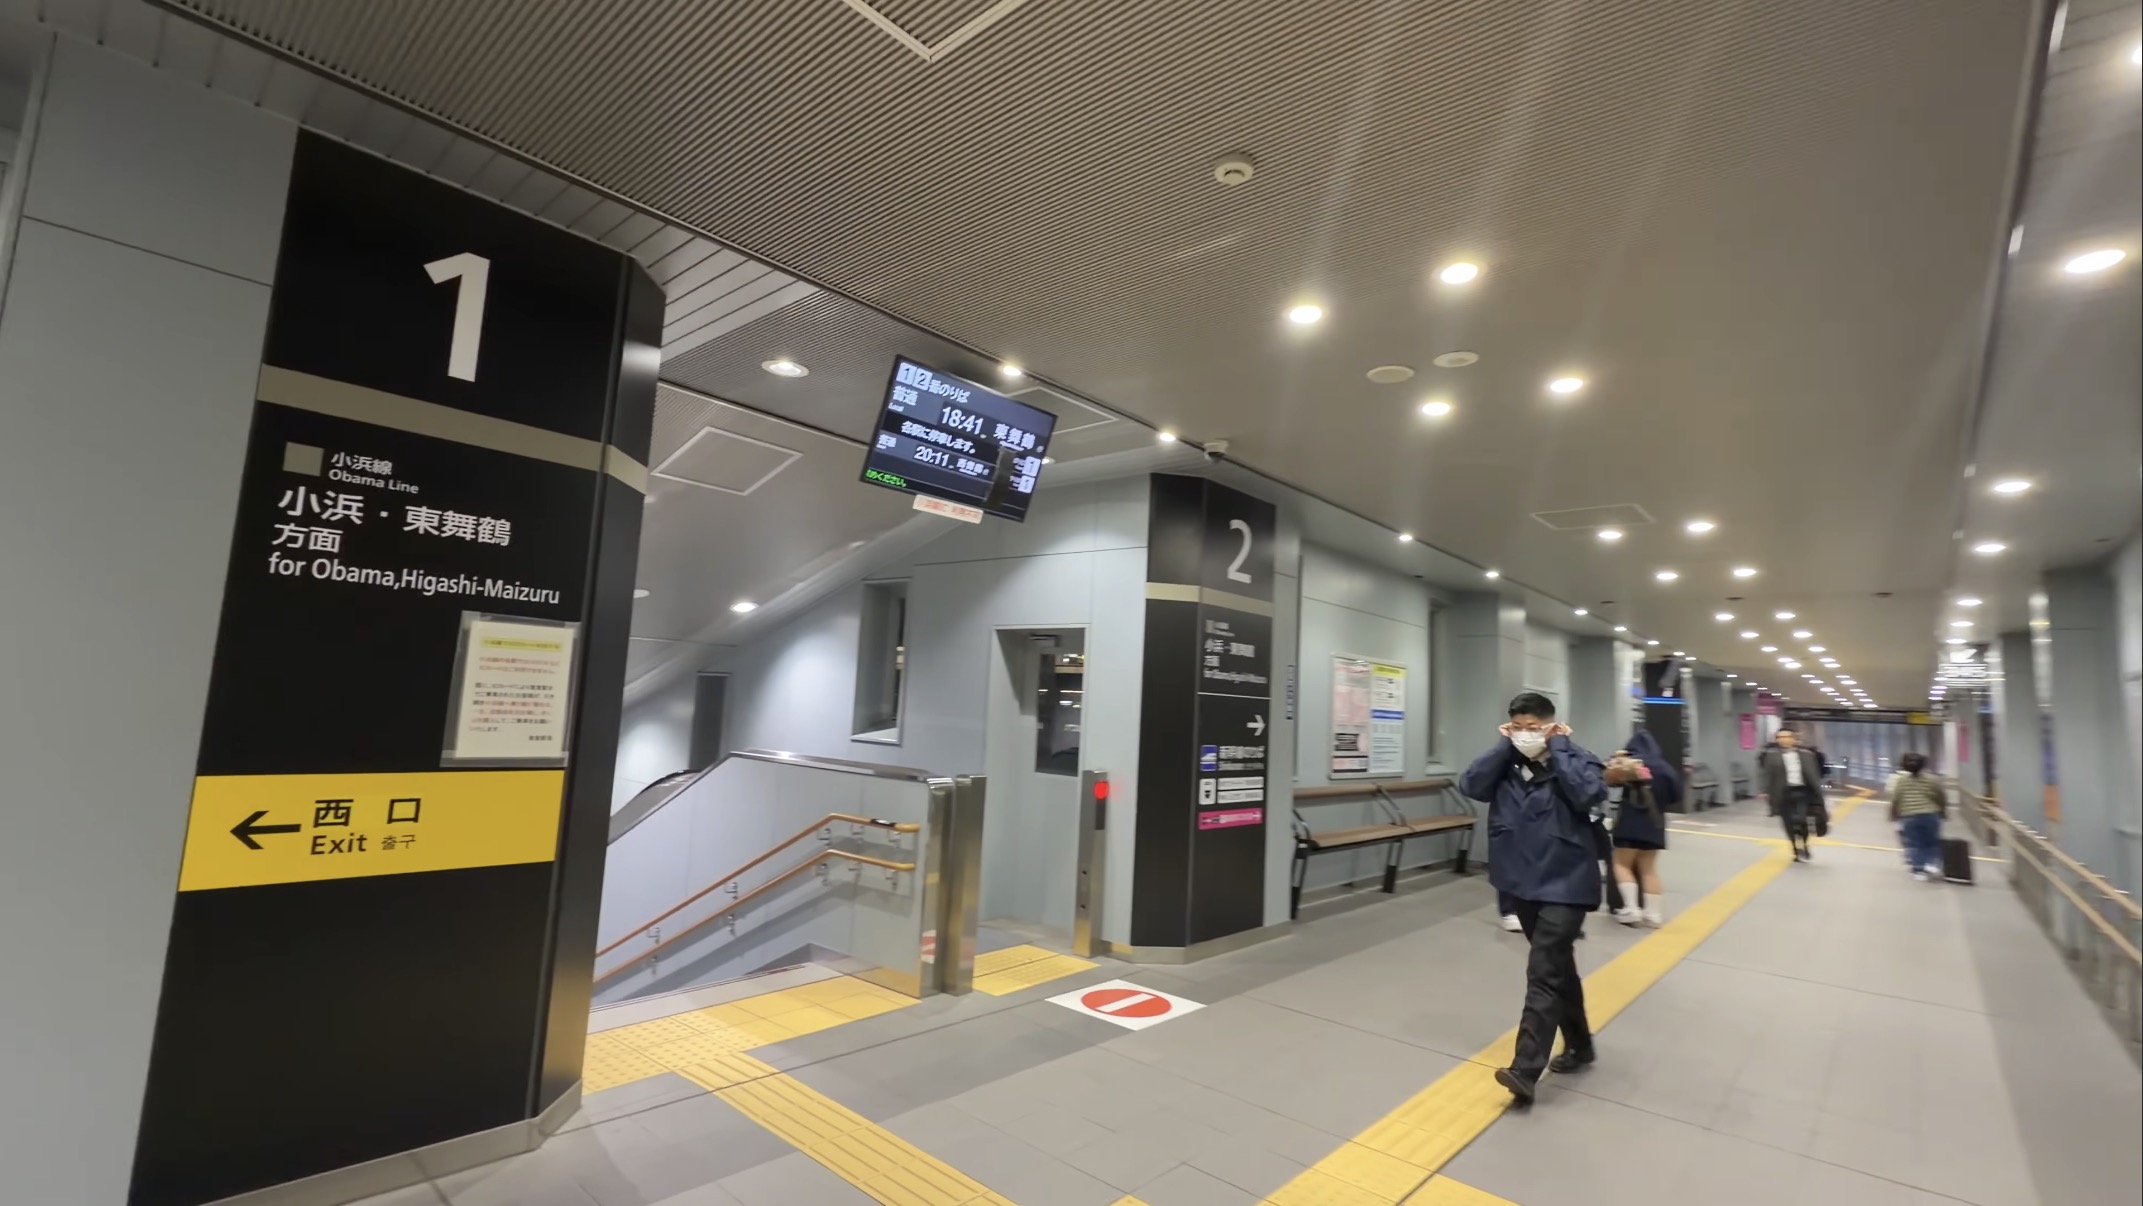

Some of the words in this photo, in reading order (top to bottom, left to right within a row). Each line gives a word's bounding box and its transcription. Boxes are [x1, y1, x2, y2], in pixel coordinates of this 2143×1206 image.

[423, 252, 490, 382] 1
[942, 406, 984, 435] 18:41
[331, 451, 393, 475] 小浜線
[914, 446, 949, 467] 20:11
[328, 469, 385, 488] Obama
[387, 479, 419, 494] Line
[271, 523, 344, 553] 方面
[268, 552, 307, 576] for
[1227, 519, 1253, 584] 2
[310, 833, 368, 855] Exit
[381, 834, 417, 851] 출구
